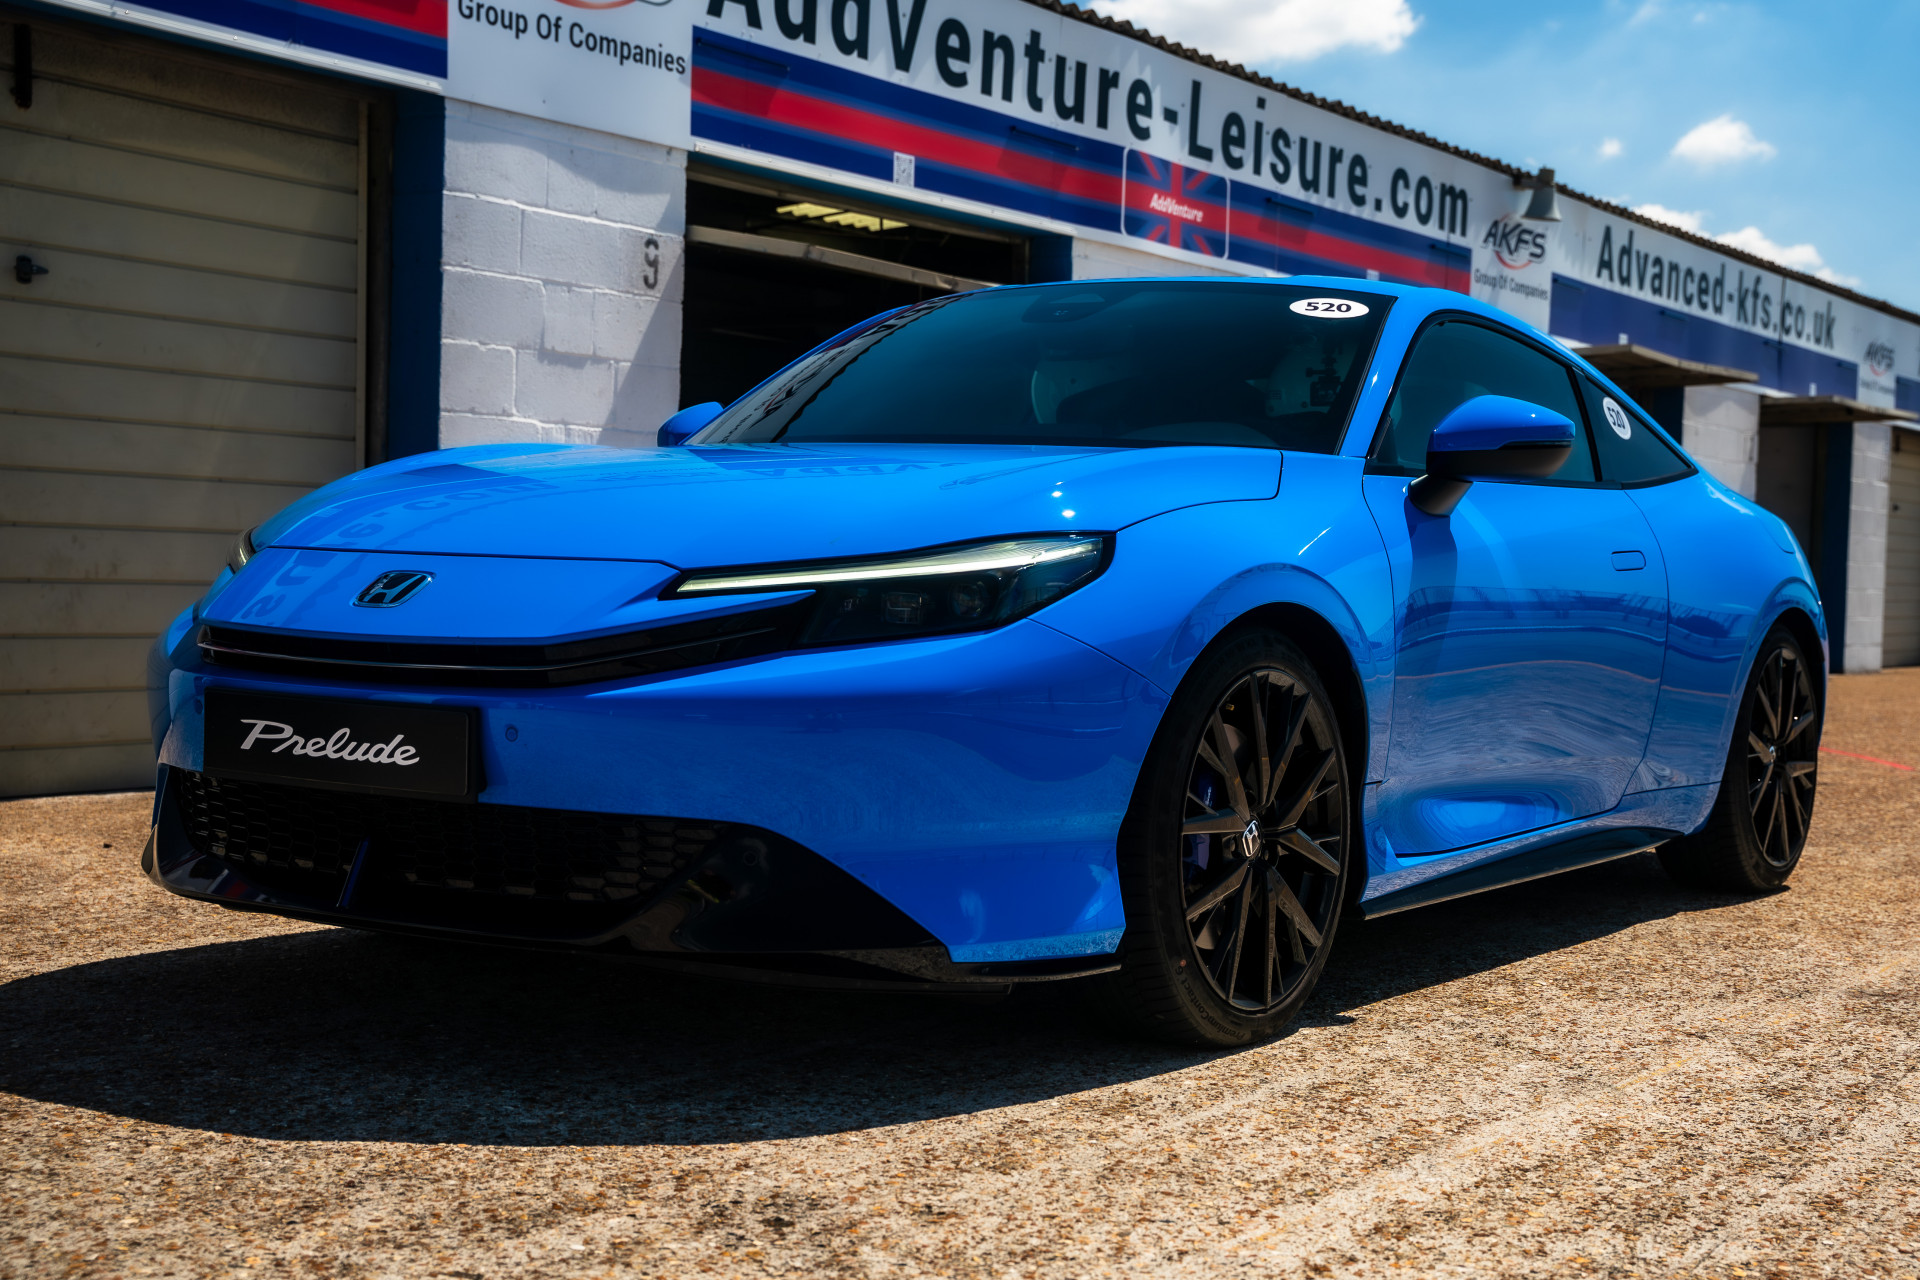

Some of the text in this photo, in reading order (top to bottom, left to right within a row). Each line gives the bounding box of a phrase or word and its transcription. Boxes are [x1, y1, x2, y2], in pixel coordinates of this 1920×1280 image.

[458, 0, 687, 75] Group Of Companies
[1149, 193, 1204, 222] AddVenture
[1482, 219, 1546, 260] AKFS
[643, 238, 660, 290] 9
[1304, 301, 1352, 313] 520
[1596, 225, 1836, 350] Advanced-kfs.co.uk
[1606, 406, 1626, 430] 520
[240, 719, 420, 766] Prelude
